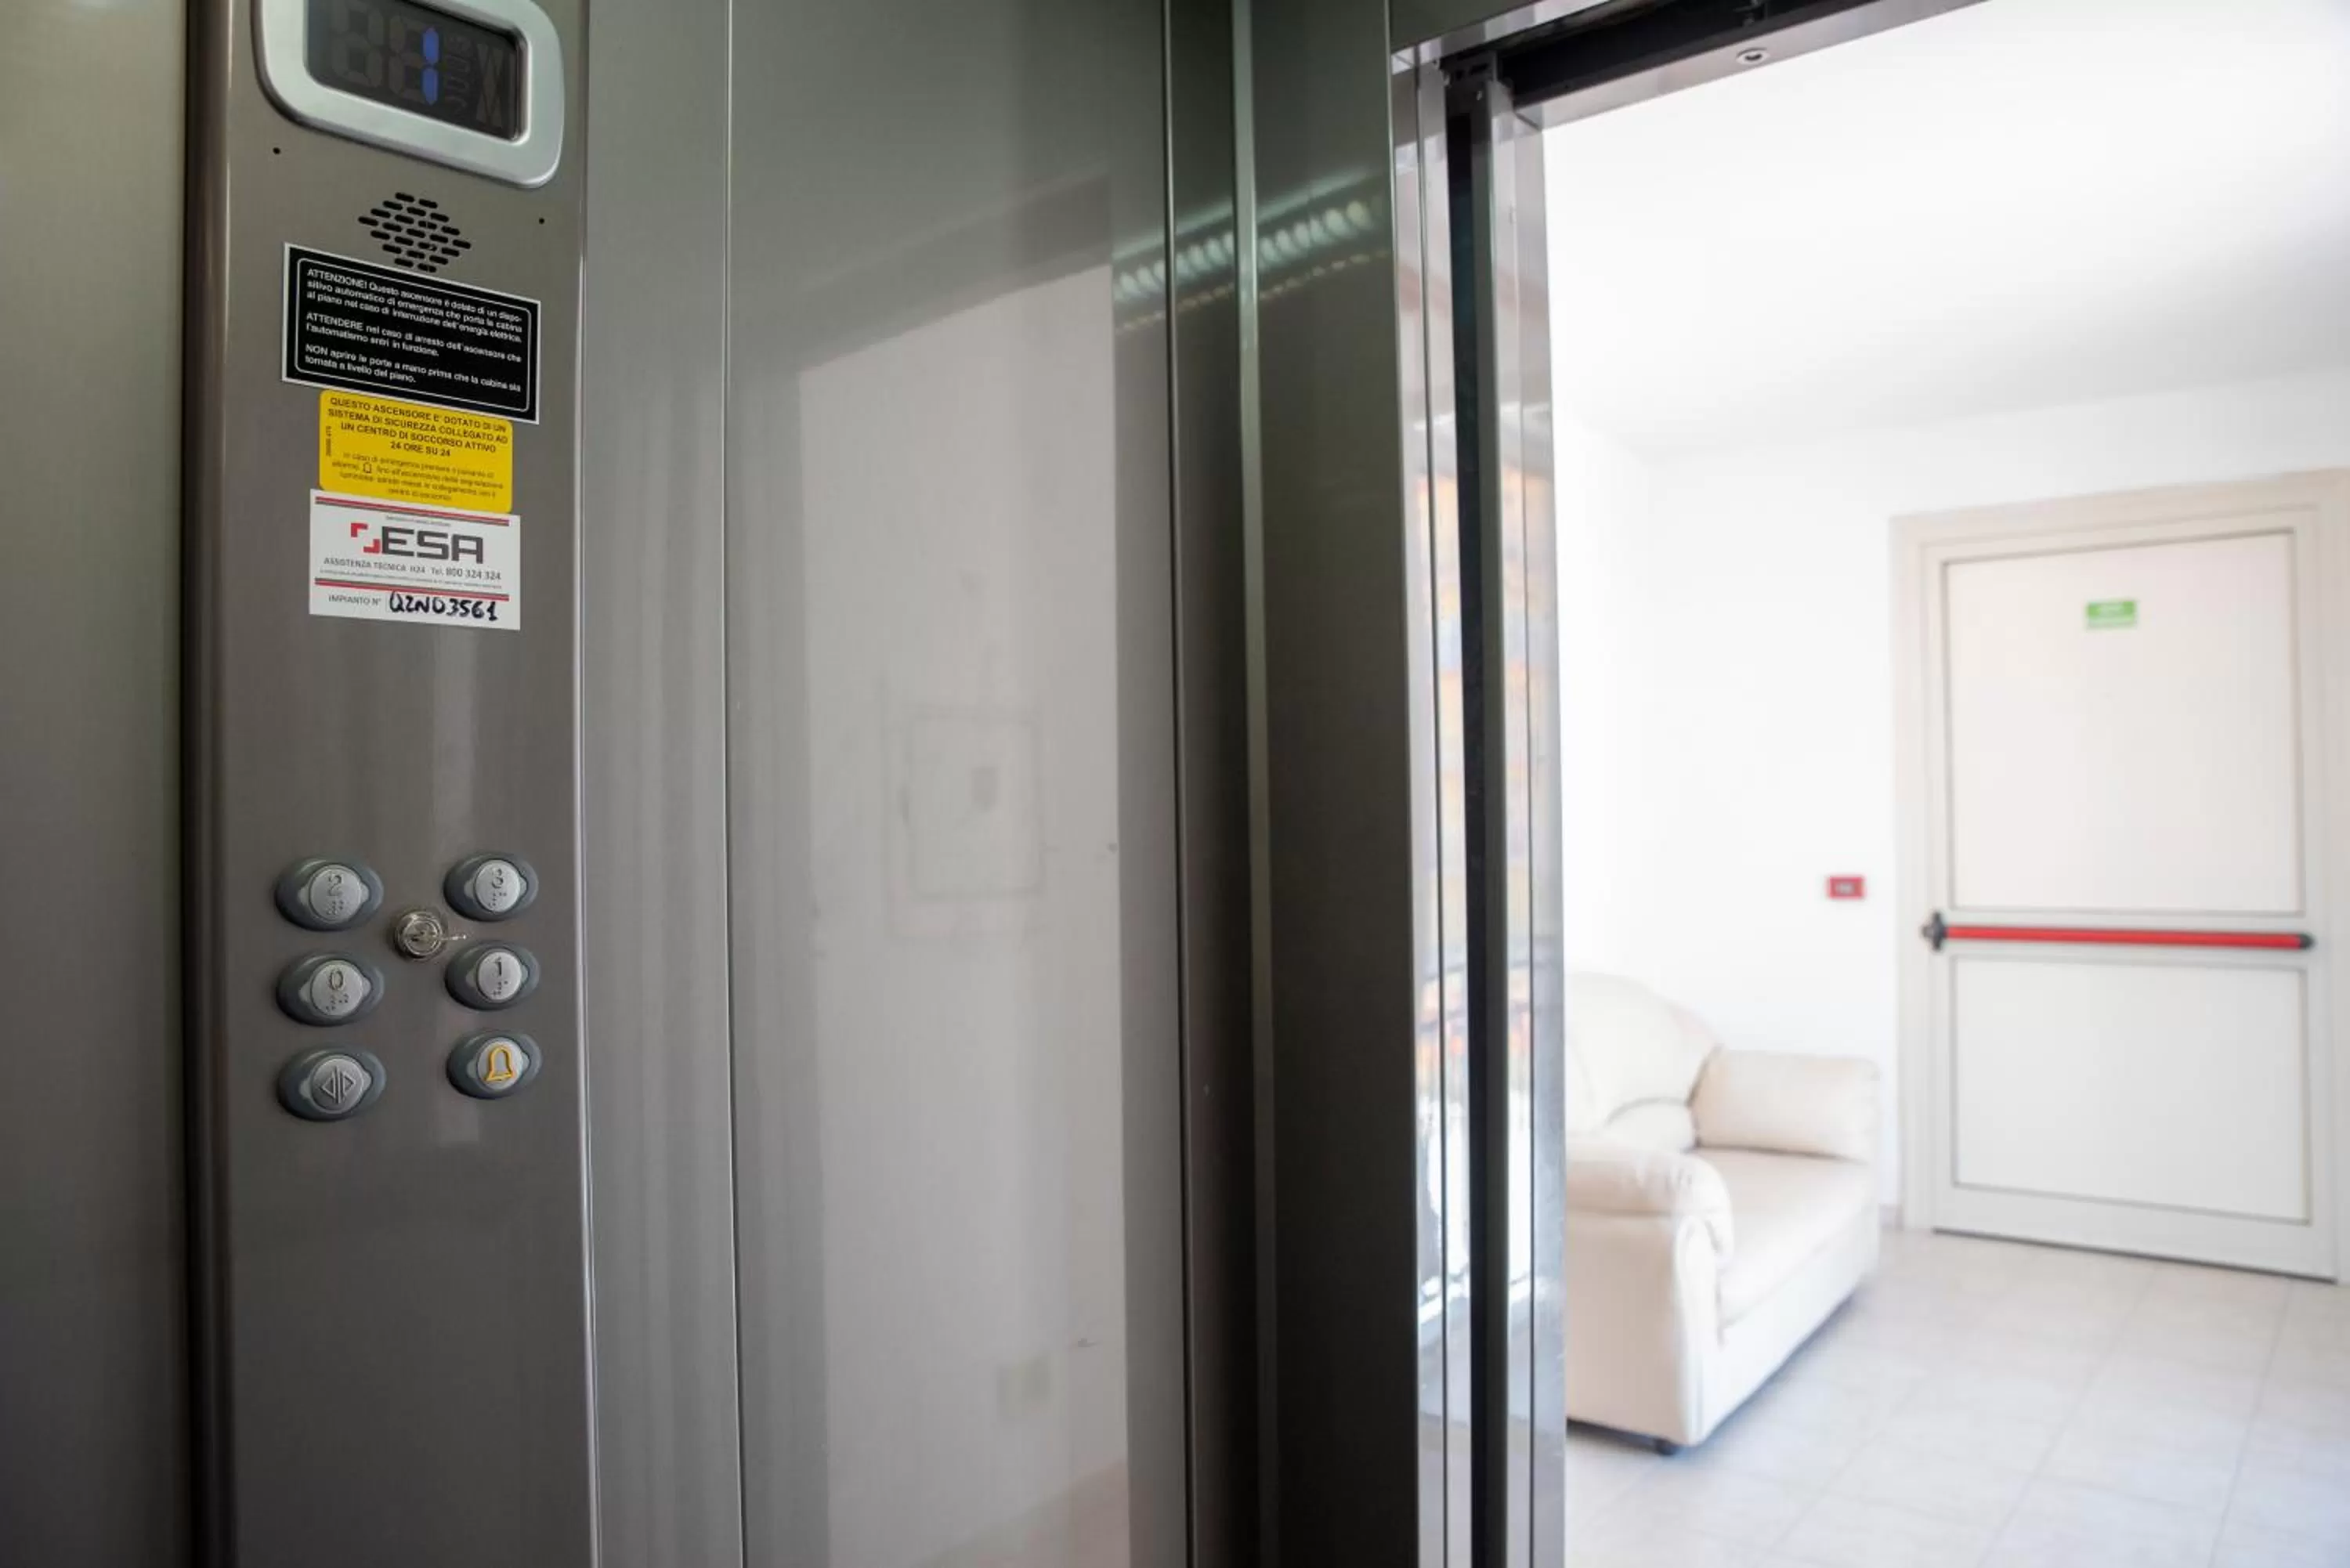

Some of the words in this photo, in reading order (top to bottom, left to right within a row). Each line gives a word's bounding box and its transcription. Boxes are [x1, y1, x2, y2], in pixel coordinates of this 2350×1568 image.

[421, 26, 440, 106] 1
[307, 269, 367, 288] ATTENZIONE!
[369, 282, 399, 295] Questo
[400, 291, 442, 305] ascensore
[334, 287, 385, 303] automatico
[446, 311, 461, 320] che
[306, 313, 363, 331] ATTENDERE
[381, 329, 402, 338] caso
[392, 340, 400, 349] in
[306, 344, 327, 355] NON
[402, 364, 426, 374] mano
[454, 374, 469, 382] che
[328, 409, 370, 421] SISTEMA
[373, 415, 382, 424] DI
[385, 418, 436, 432] SICUREZZA
[439, 426, 494, 441] COLLEGATO
[331, 397, 371, 410] QUESTO
[374, 404, 431, 420] ASCENSORE
[444, 416, 480, 428] DOTATO
[341, 422, 354, 431] UN
[356, 425, 397, 437] CENTRO
[399, 431, 408, 439] DI
[410, 432, 463, 447] SOCCORSO
[465, 441, 496, 453] ATTIVO
[403, 443, 423, 453] ORE
[426, 446, 438, 455] SU
[381, 526, 483, 564] ESA
[324, 558, 371, 568] ASSISTENZA
[374, 562, 406, 571] TECNICA
[446, 568, 463, 577] 800
[466, 569, 482, 579] 324
[486, 572, 501, 580] 324
[328, 594, 371, 605] IMPIANTO
[327, 970, 345, 991] 0
[493, 956, 504, 977] 1
